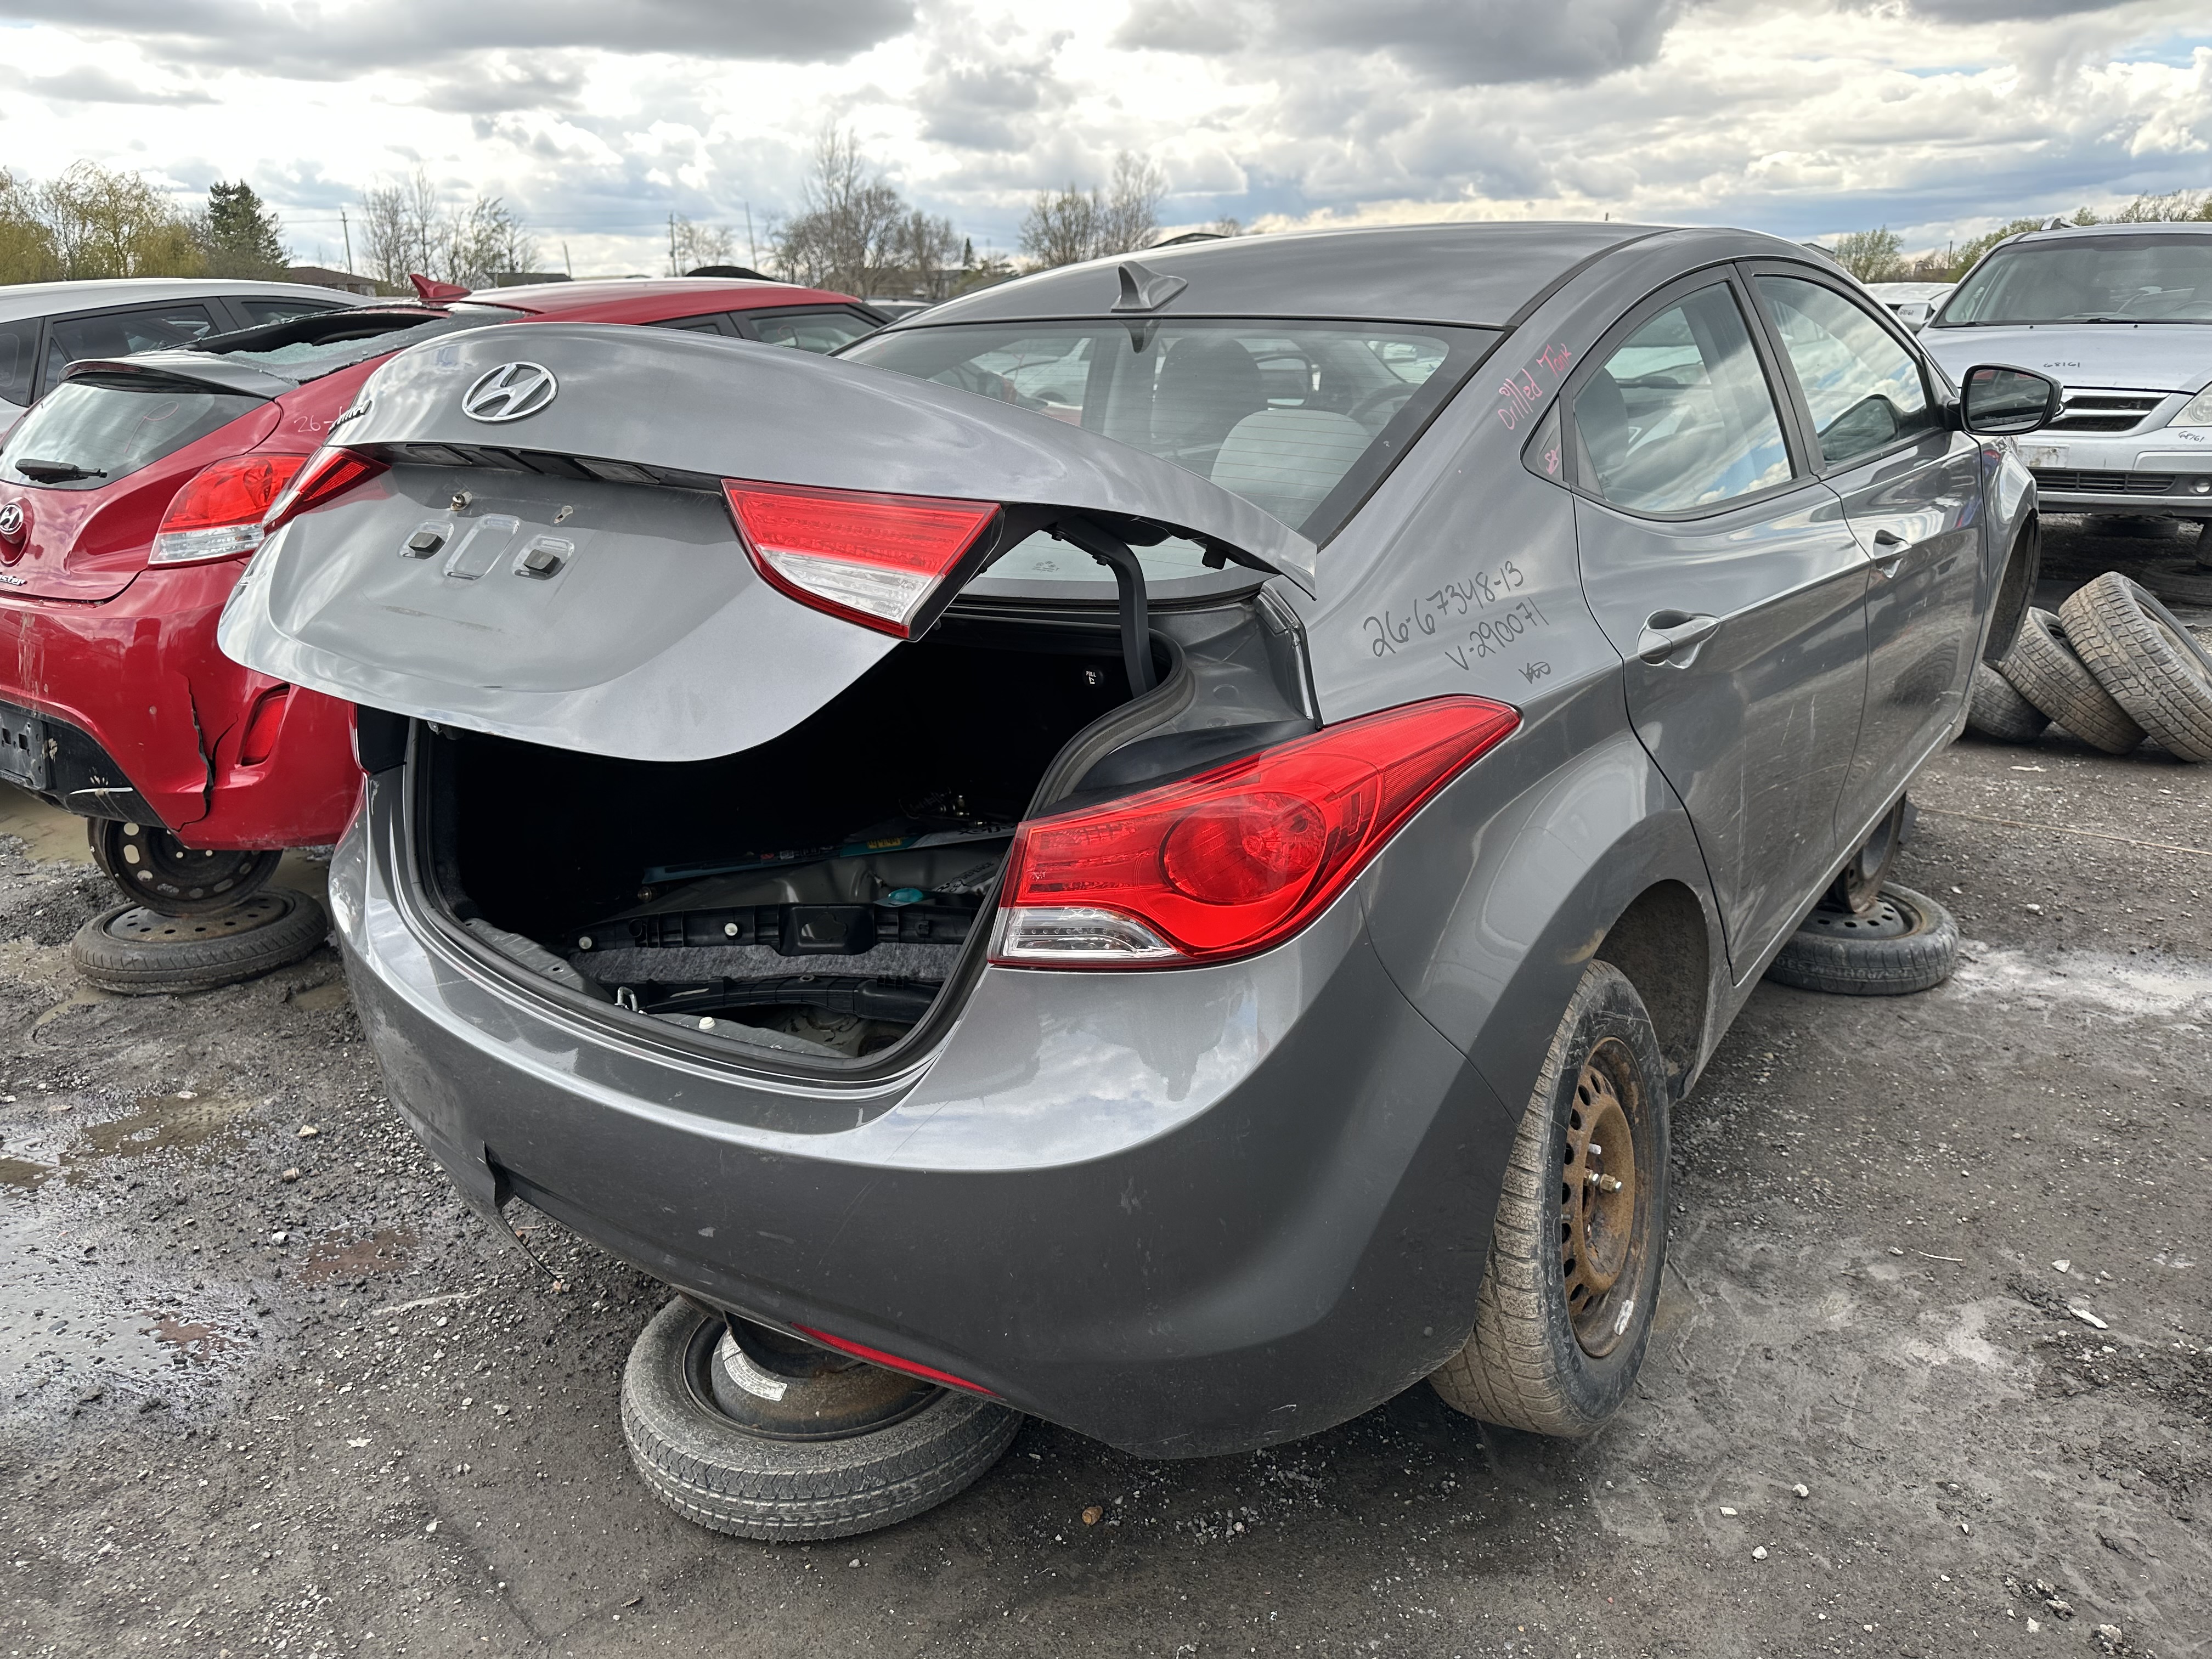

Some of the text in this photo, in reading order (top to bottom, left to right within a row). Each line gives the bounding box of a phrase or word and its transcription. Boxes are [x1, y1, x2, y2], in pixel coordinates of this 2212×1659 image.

[1498, 368, 1543, 430] Drilled
[2178, 431, 2204, 442] 68161
[1444, 596, 1549, 671] V-290071
